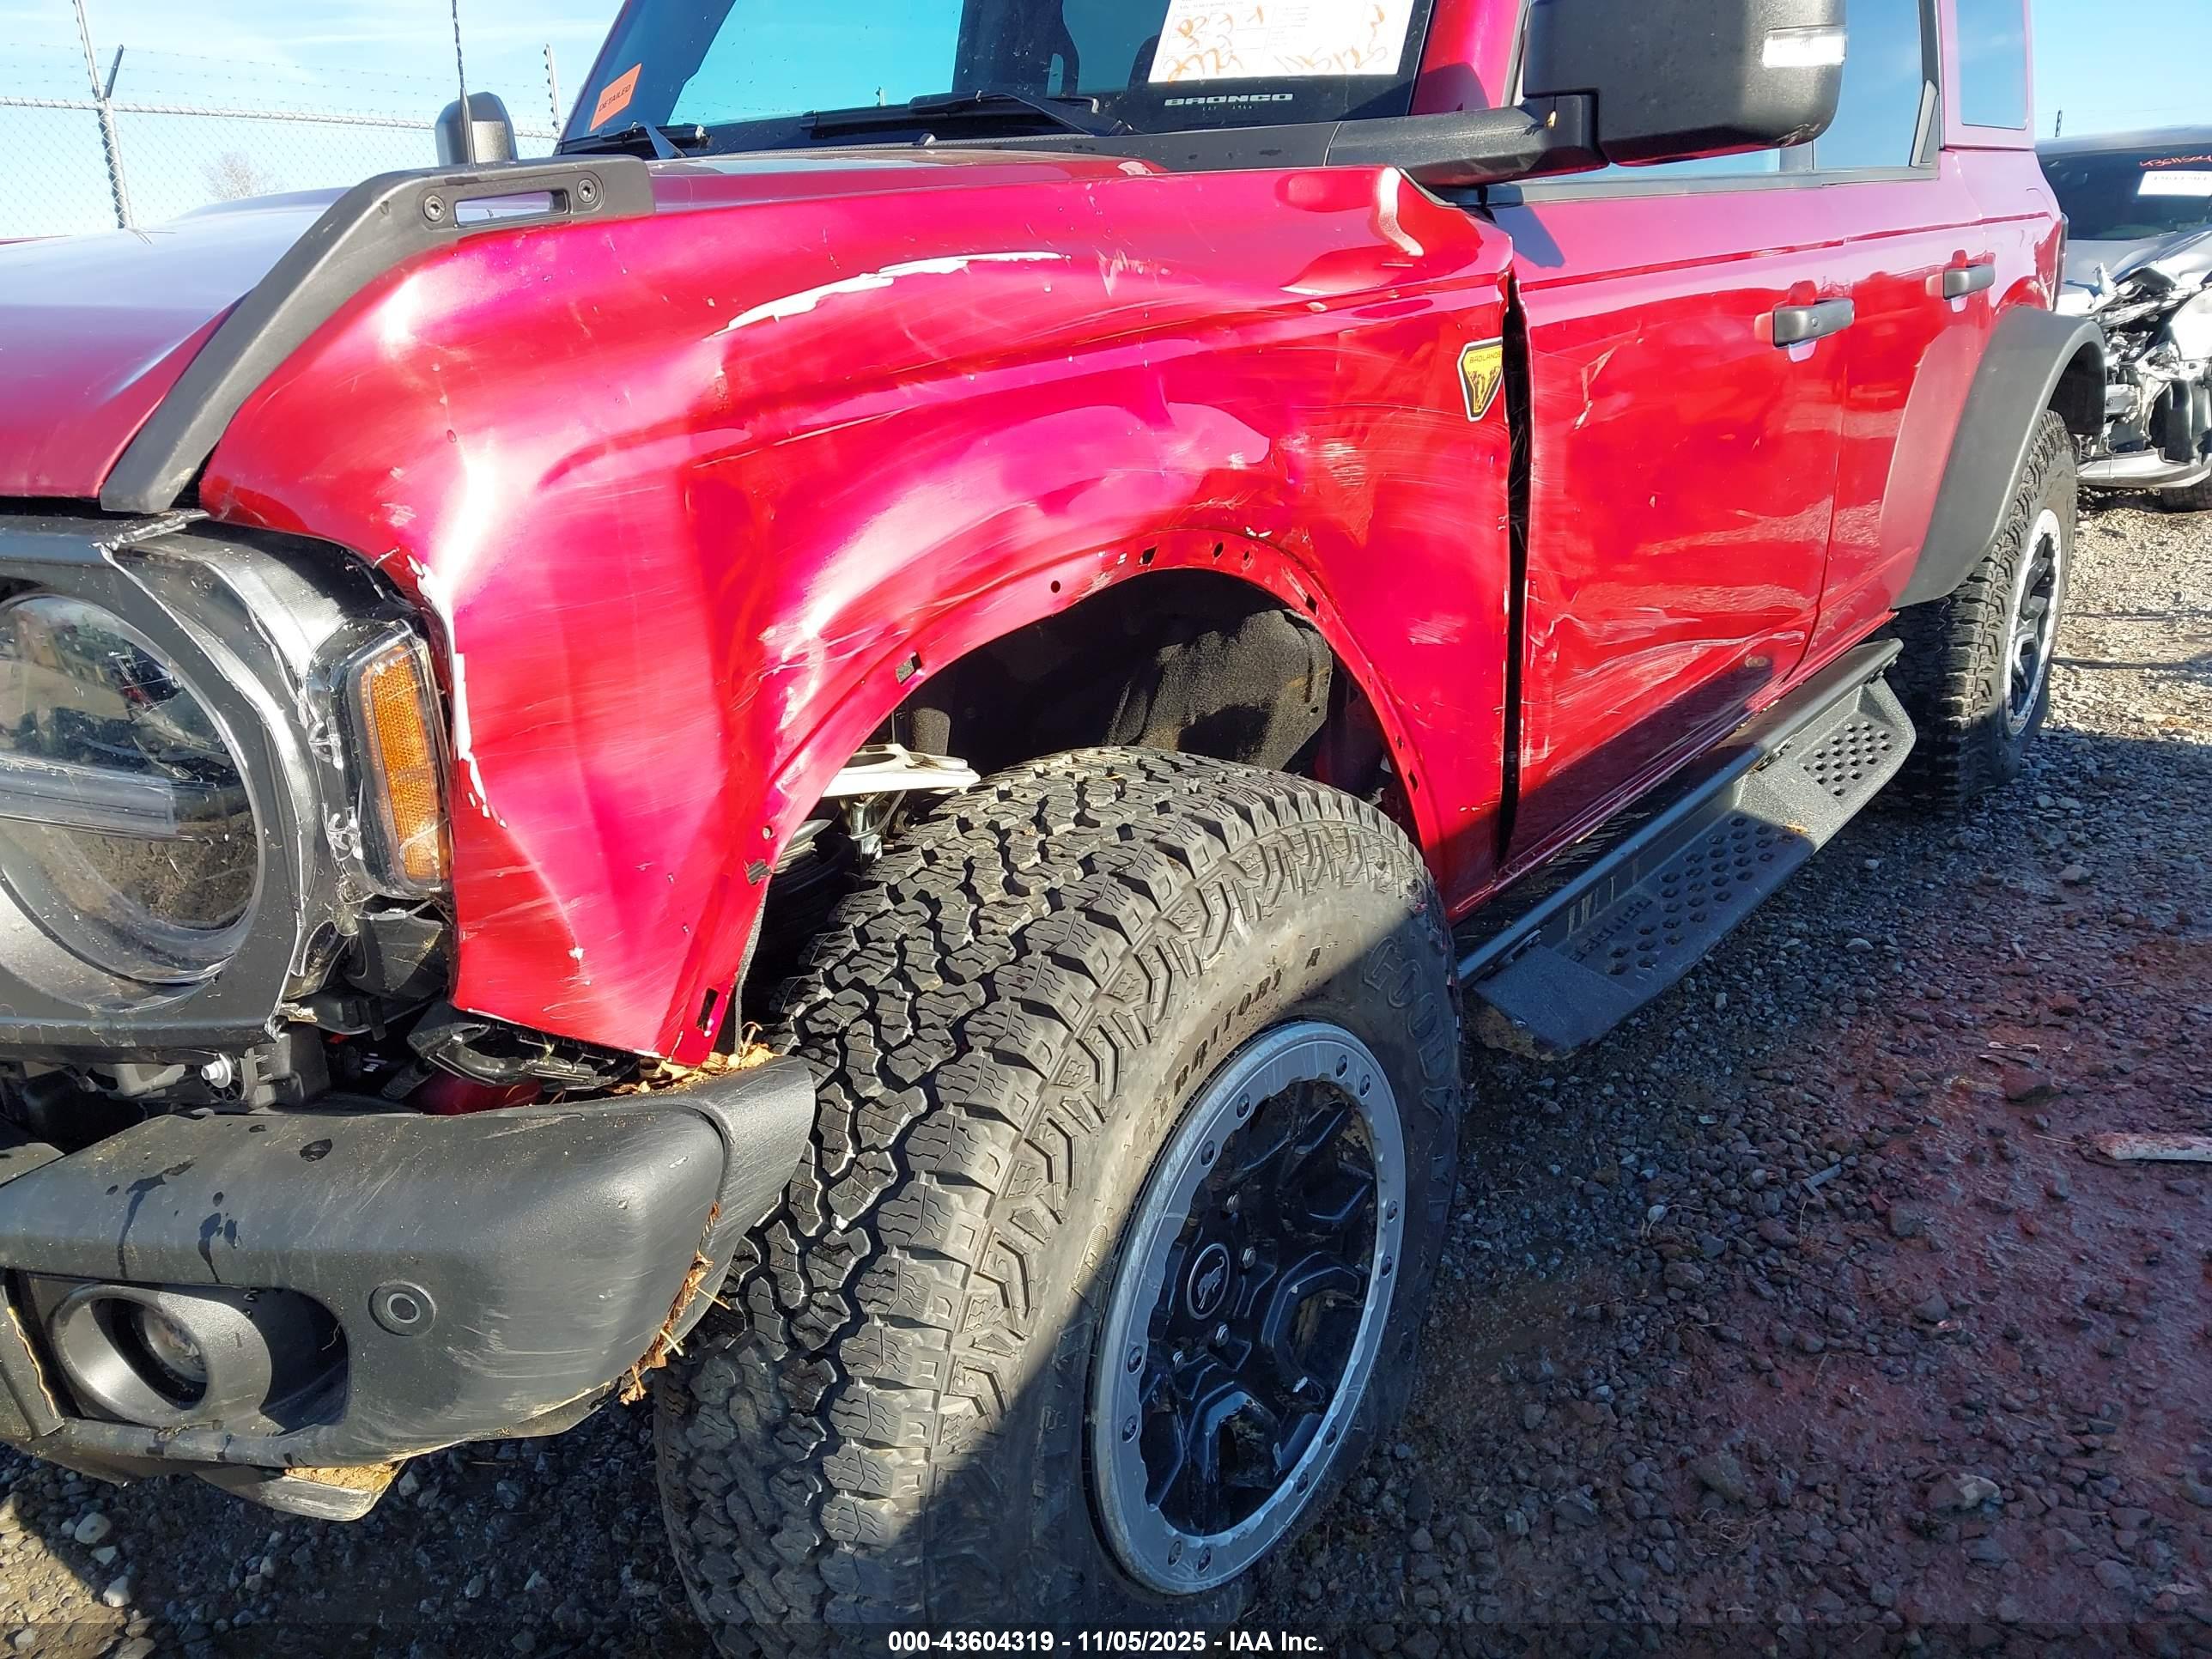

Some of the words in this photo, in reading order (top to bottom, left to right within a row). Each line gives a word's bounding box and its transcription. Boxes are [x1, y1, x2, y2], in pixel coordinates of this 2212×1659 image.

[598, 84, 632, 112] DETAILED
[1164, 93, 1294, 107] BRONCO
[1469, 351, 1501, 364] BADLANDS
